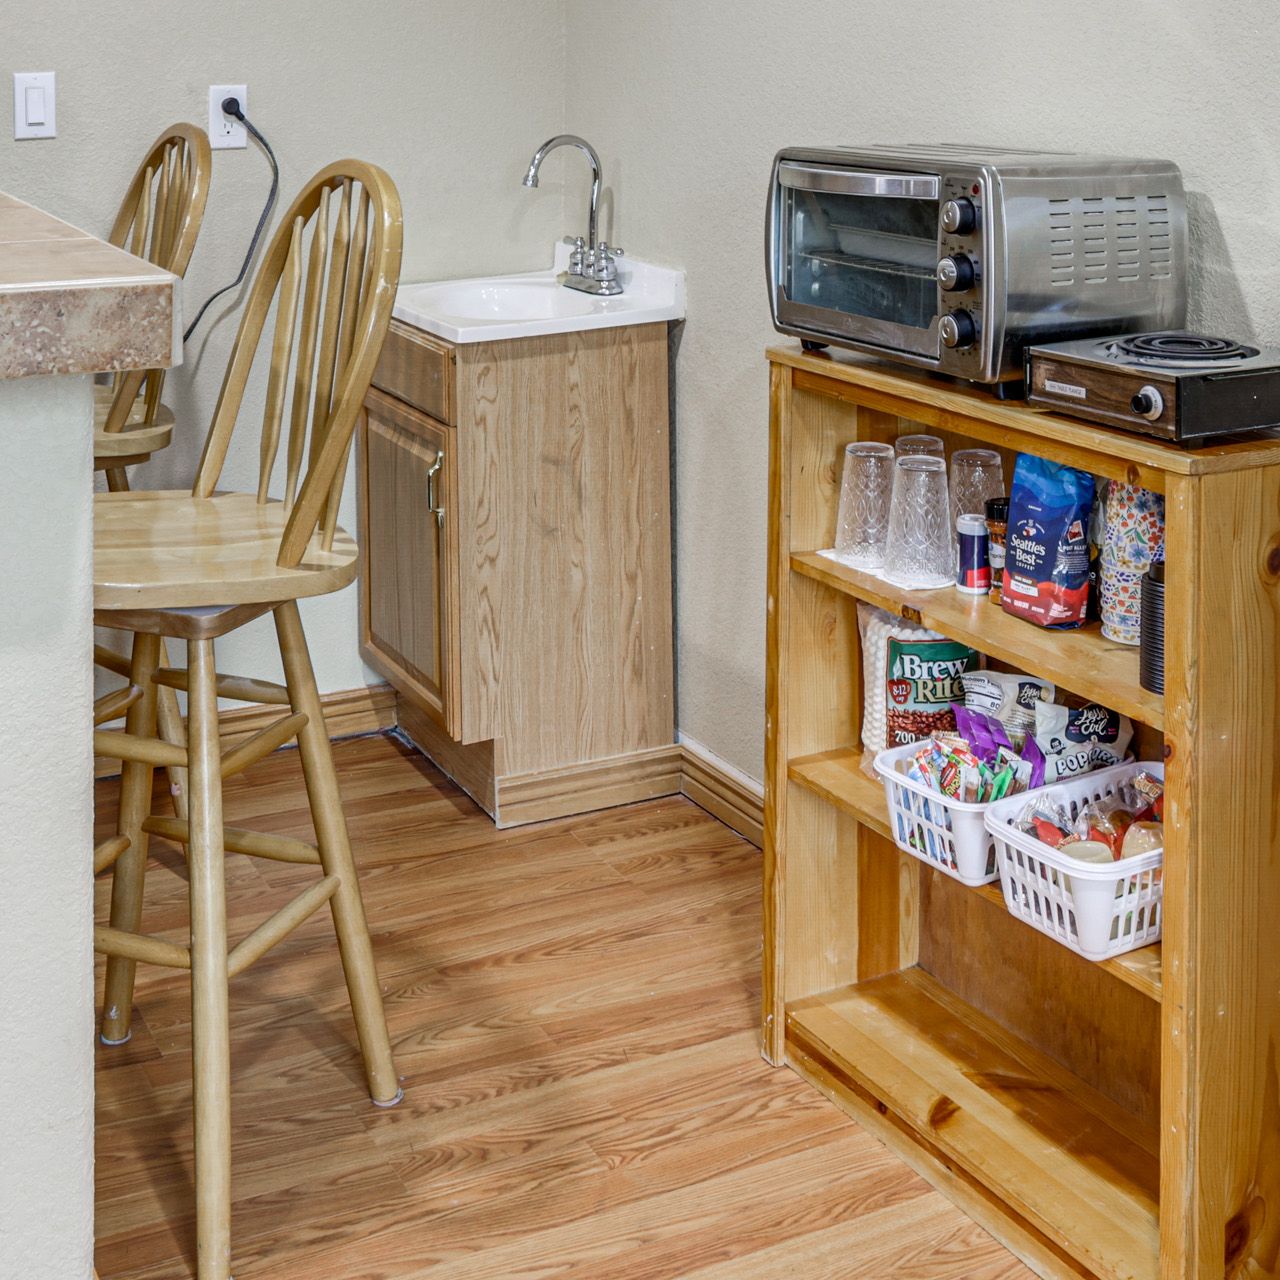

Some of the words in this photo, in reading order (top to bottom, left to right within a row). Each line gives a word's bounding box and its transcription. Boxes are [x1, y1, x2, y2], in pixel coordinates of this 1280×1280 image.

[1010, 534, 1046, 556] Seattle's
[1016, 550, 1036, 566] Best
[901, 655, 968, 680] Brew
[892, 684, 907, 696] 8-12
[915, 675, 964, 702] Rite
[1074, 707, 1109, 725] Lesser
[1081, 719, 1106, 736] Evil
[895, 731, 916, 744] 700
